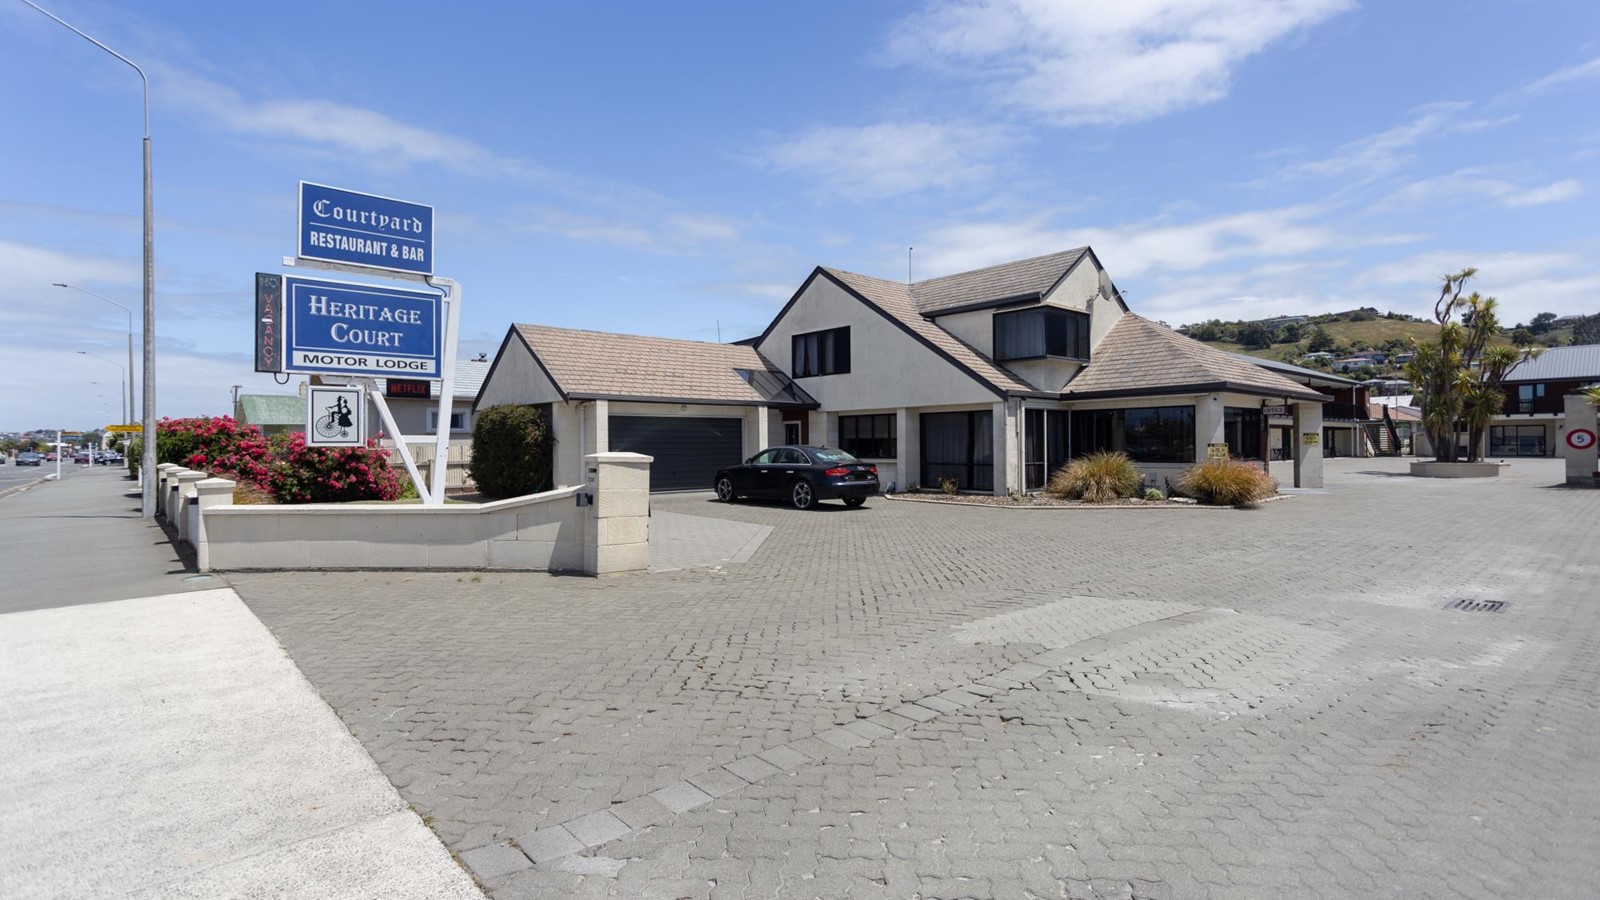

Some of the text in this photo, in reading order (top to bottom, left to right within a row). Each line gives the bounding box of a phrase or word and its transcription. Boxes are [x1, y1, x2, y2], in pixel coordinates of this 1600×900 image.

[313, 199, 422, 233] Courtyard
[310, 231, 424, 261] RESTAURANT & BAR
[309, 295, 422, 325] HERITAGE
[262, 293, 274, 367] VACANCY
[331, 322, 403, 347] COURT
[303, 354, 428, 370] MOTOR LODGE
[390, 383, 426, 394] NETFLIX
[1577, 434, 1585, 444] 5
